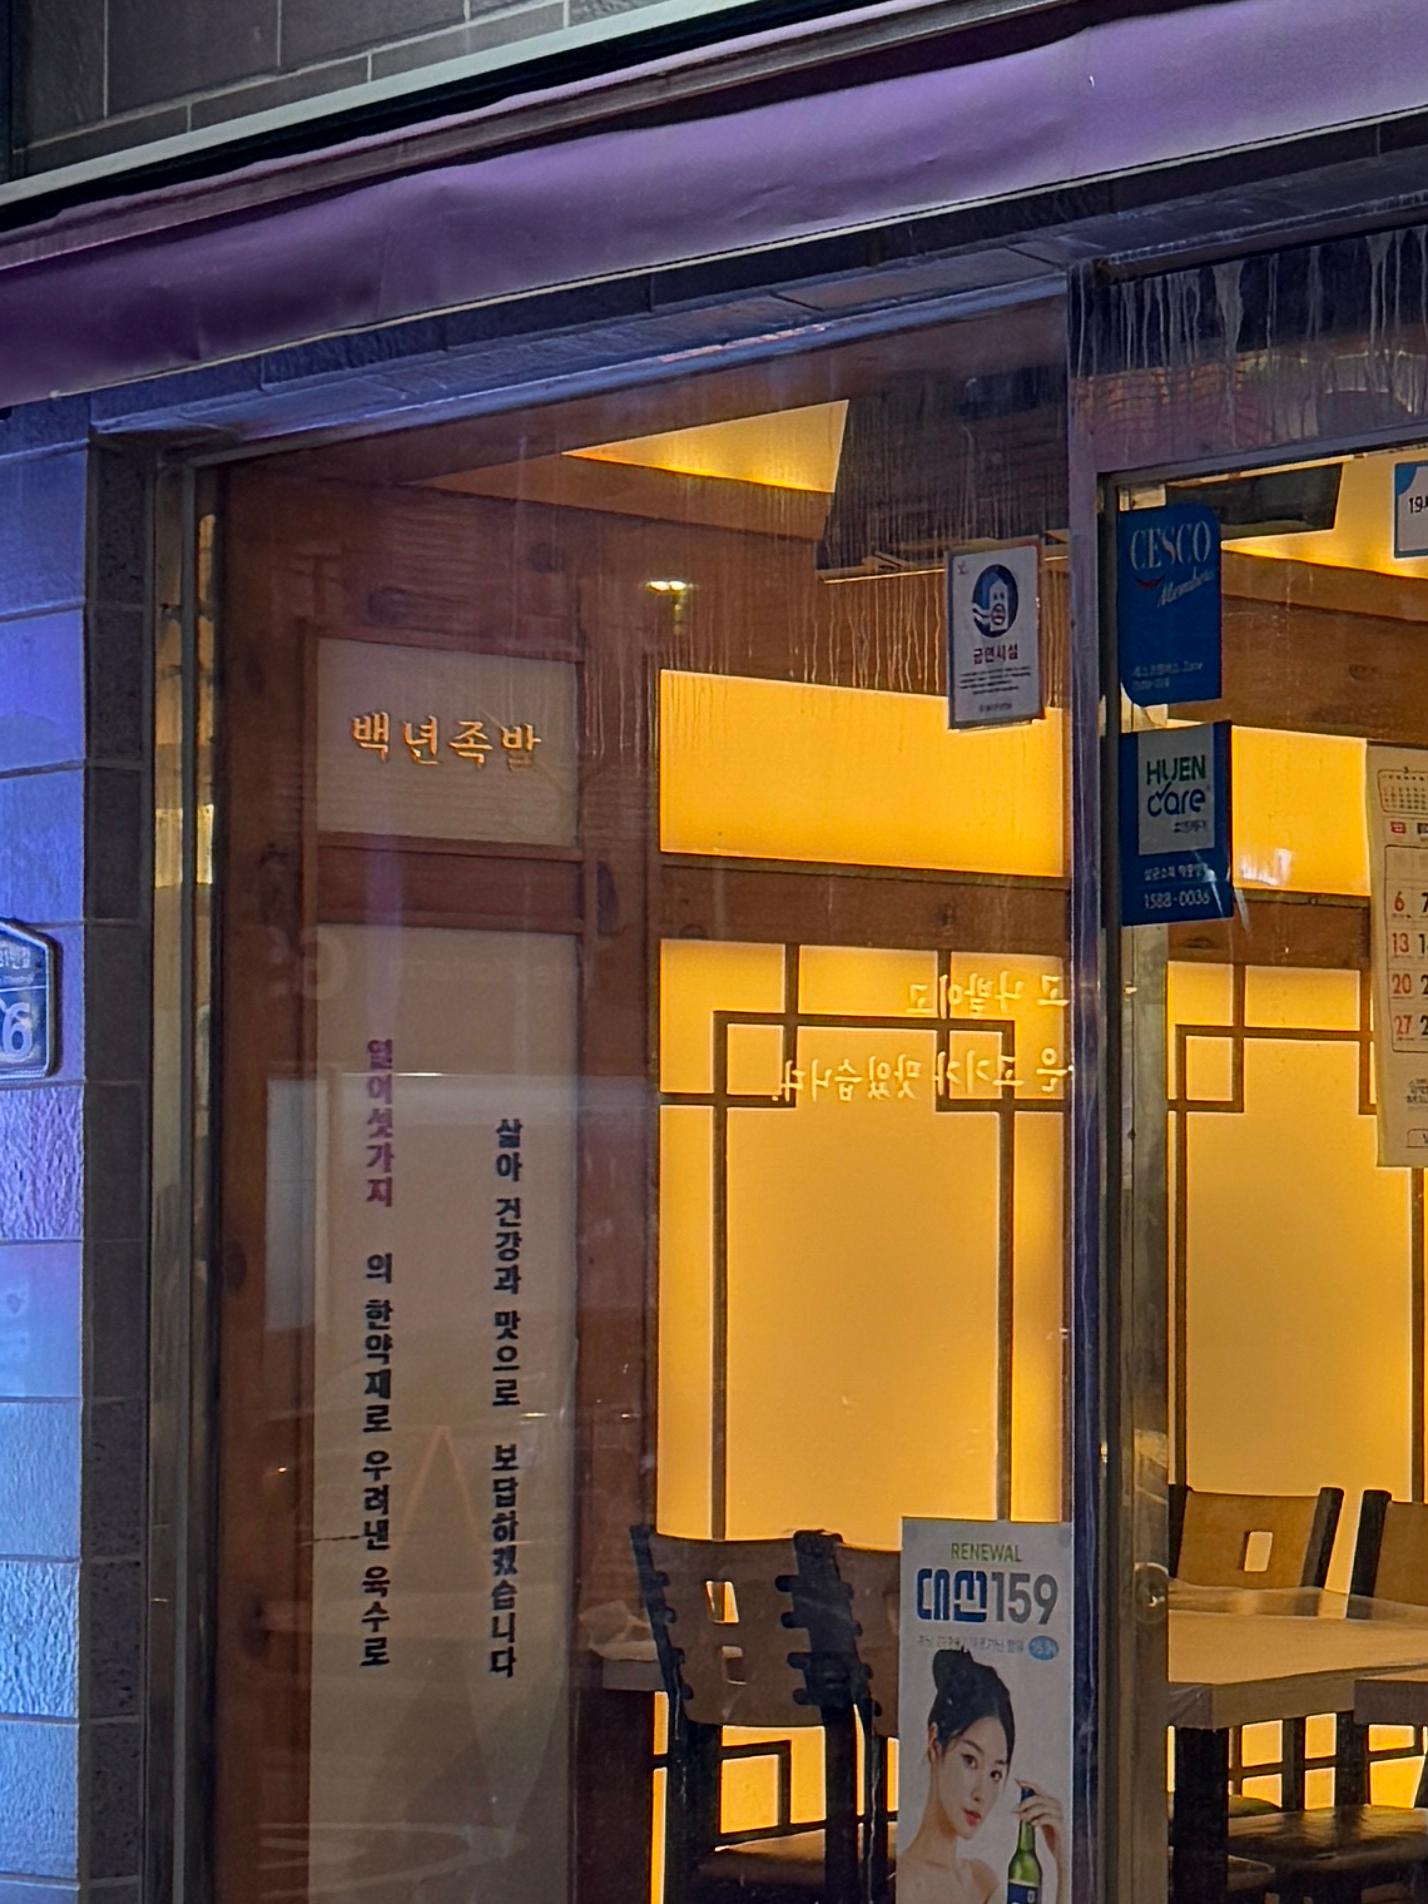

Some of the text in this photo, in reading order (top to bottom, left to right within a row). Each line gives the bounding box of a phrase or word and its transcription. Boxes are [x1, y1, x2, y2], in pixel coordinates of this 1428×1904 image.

[1130, 520, 1212, 571] CESCO
[351, 711, 541, 768] 백년족발
[1146, 754, 1206, 786] HUEN
[1393, 891, 1406, 913] 6
[1391, 932, 1410, 954] 13
[1391, 973, 1412, 995] 20
[1393, 1016, 1412, 1036] 27
[494, 1197, 522, 1295] 건강과
[366, 1252, 393, 1284] 의
[493, 1310, 522, 1407] 맛으로
[363, 1449, 392, 1551] 우려낸
[489, 1443, 520, 1678] 보답하겠습니다
[951, 1542, 1023, 1563] RENEWAL
[360, 1565, 391, 1668] 육수로
